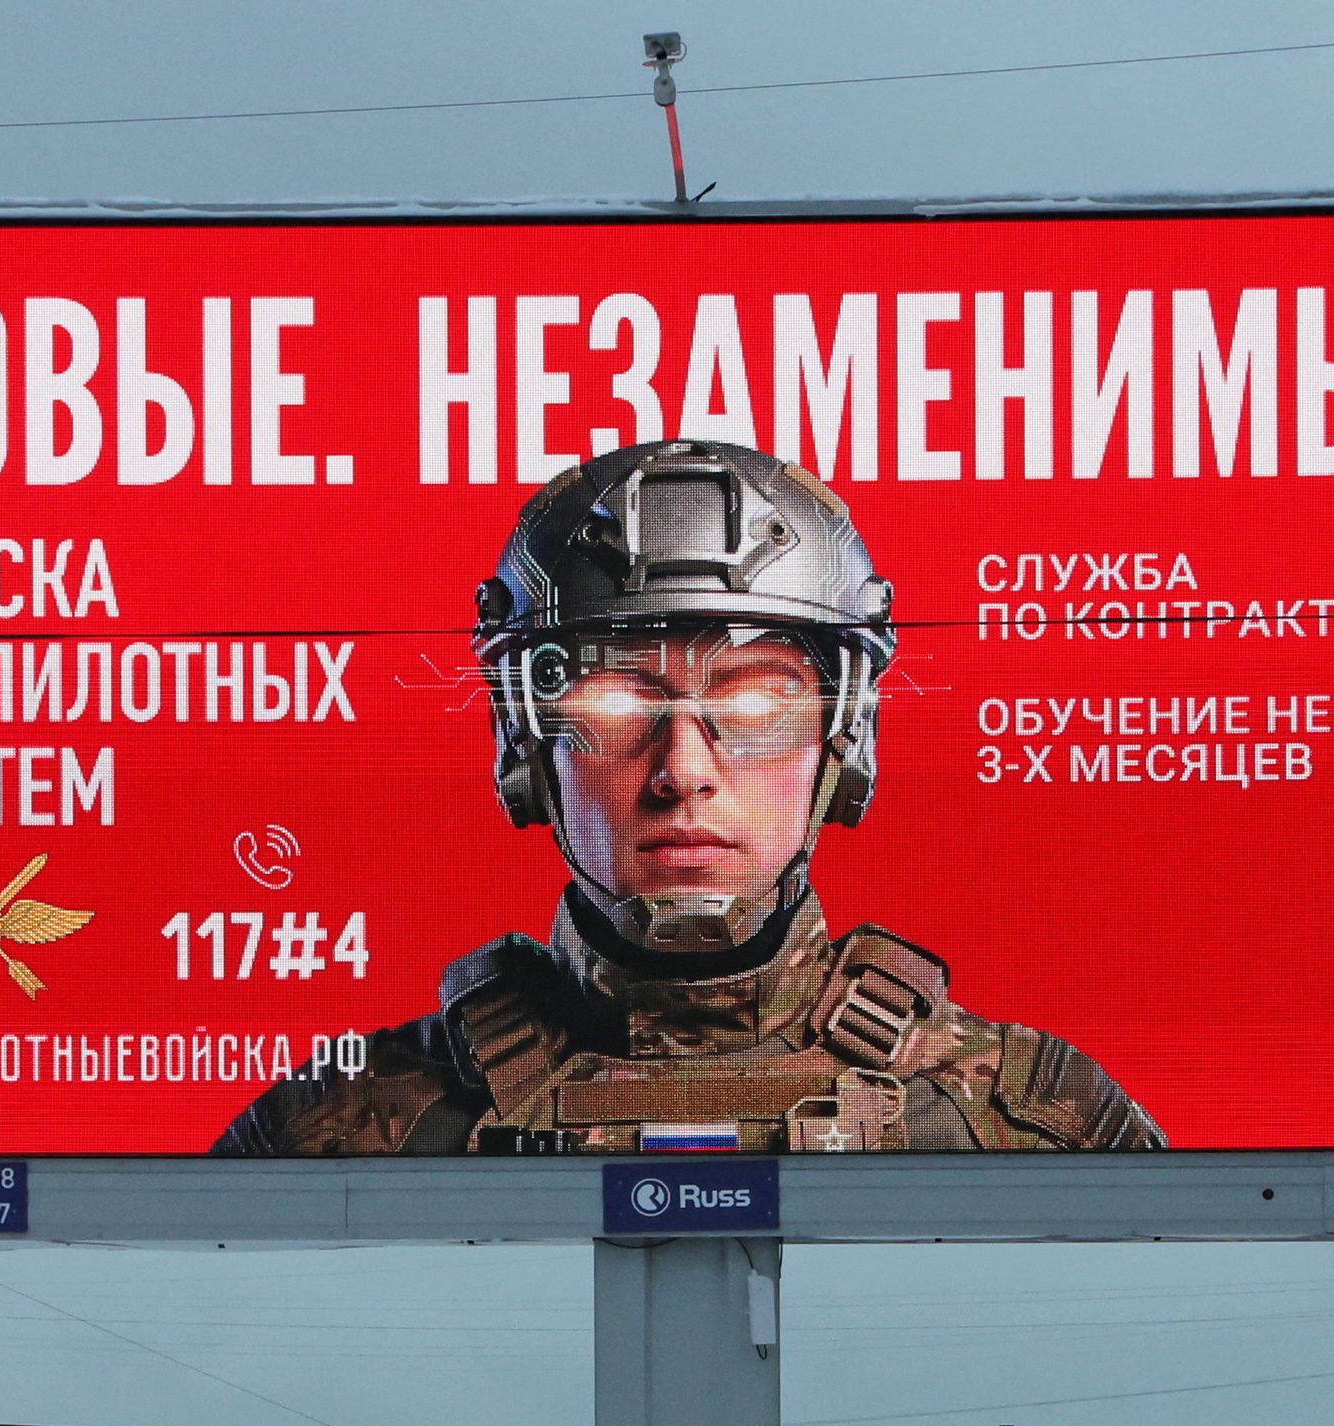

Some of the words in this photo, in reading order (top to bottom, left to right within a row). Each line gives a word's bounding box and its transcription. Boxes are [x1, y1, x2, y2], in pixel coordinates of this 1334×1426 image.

[977, 552, 1198, 592] СЛУЖБА
[978, 602, 1047, 641] ПО
[978, 696, 1251, 737] ОБУЧЕНИЕ
[1267, 695, 1332, 735] НЕ
[976, 744, 1053, 783] 3-Х
[1069, 742, 1313, 790] МЕСЯЦЕВ
[161, 911, 370, 980] 117#4
[679, 1184, 751, 1209] Russ
